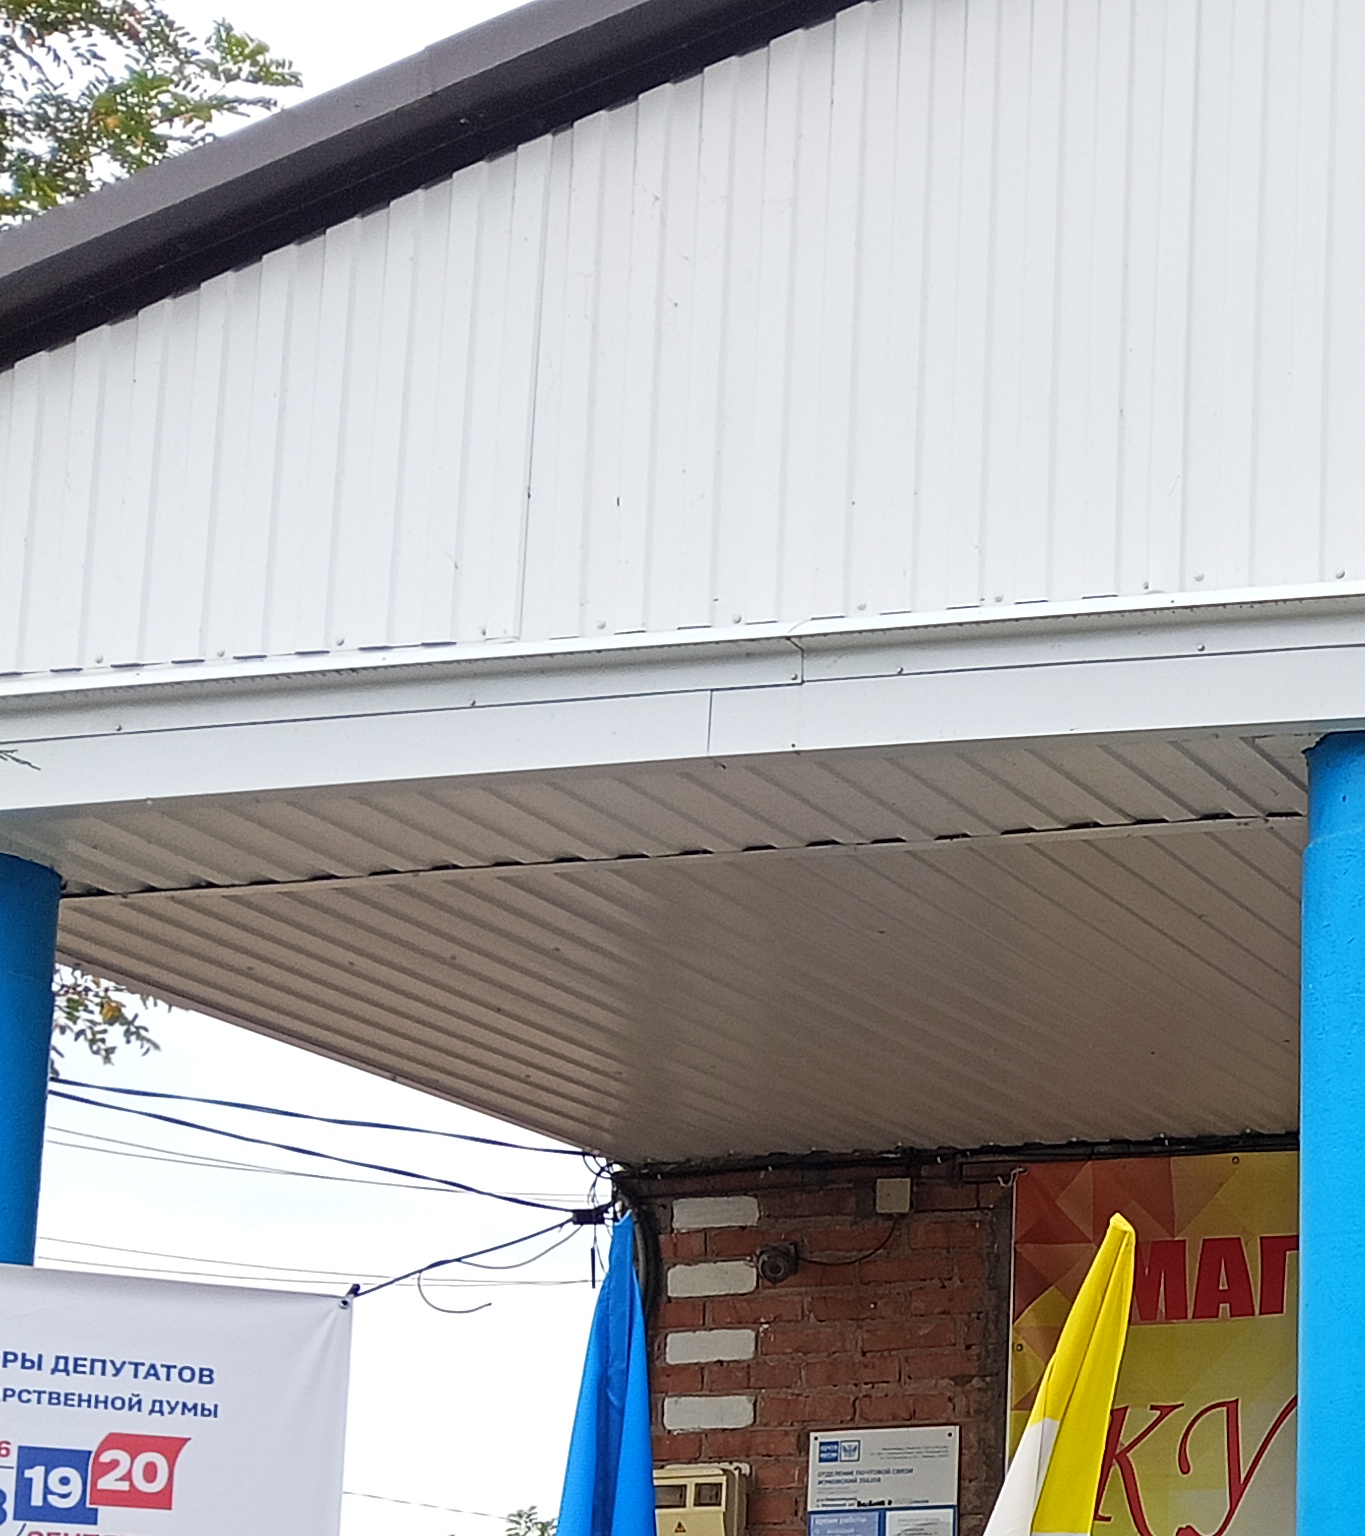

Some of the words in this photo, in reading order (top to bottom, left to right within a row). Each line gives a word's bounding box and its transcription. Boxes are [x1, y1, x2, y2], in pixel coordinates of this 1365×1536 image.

[50, 1354, 215, 1386] ДЕПУТАТОВ
[148, 1399, 220, 1419] ДУМЫ
[23, 1465, 83, 1509] 19
[97, 1448, 170, 1494] 20
